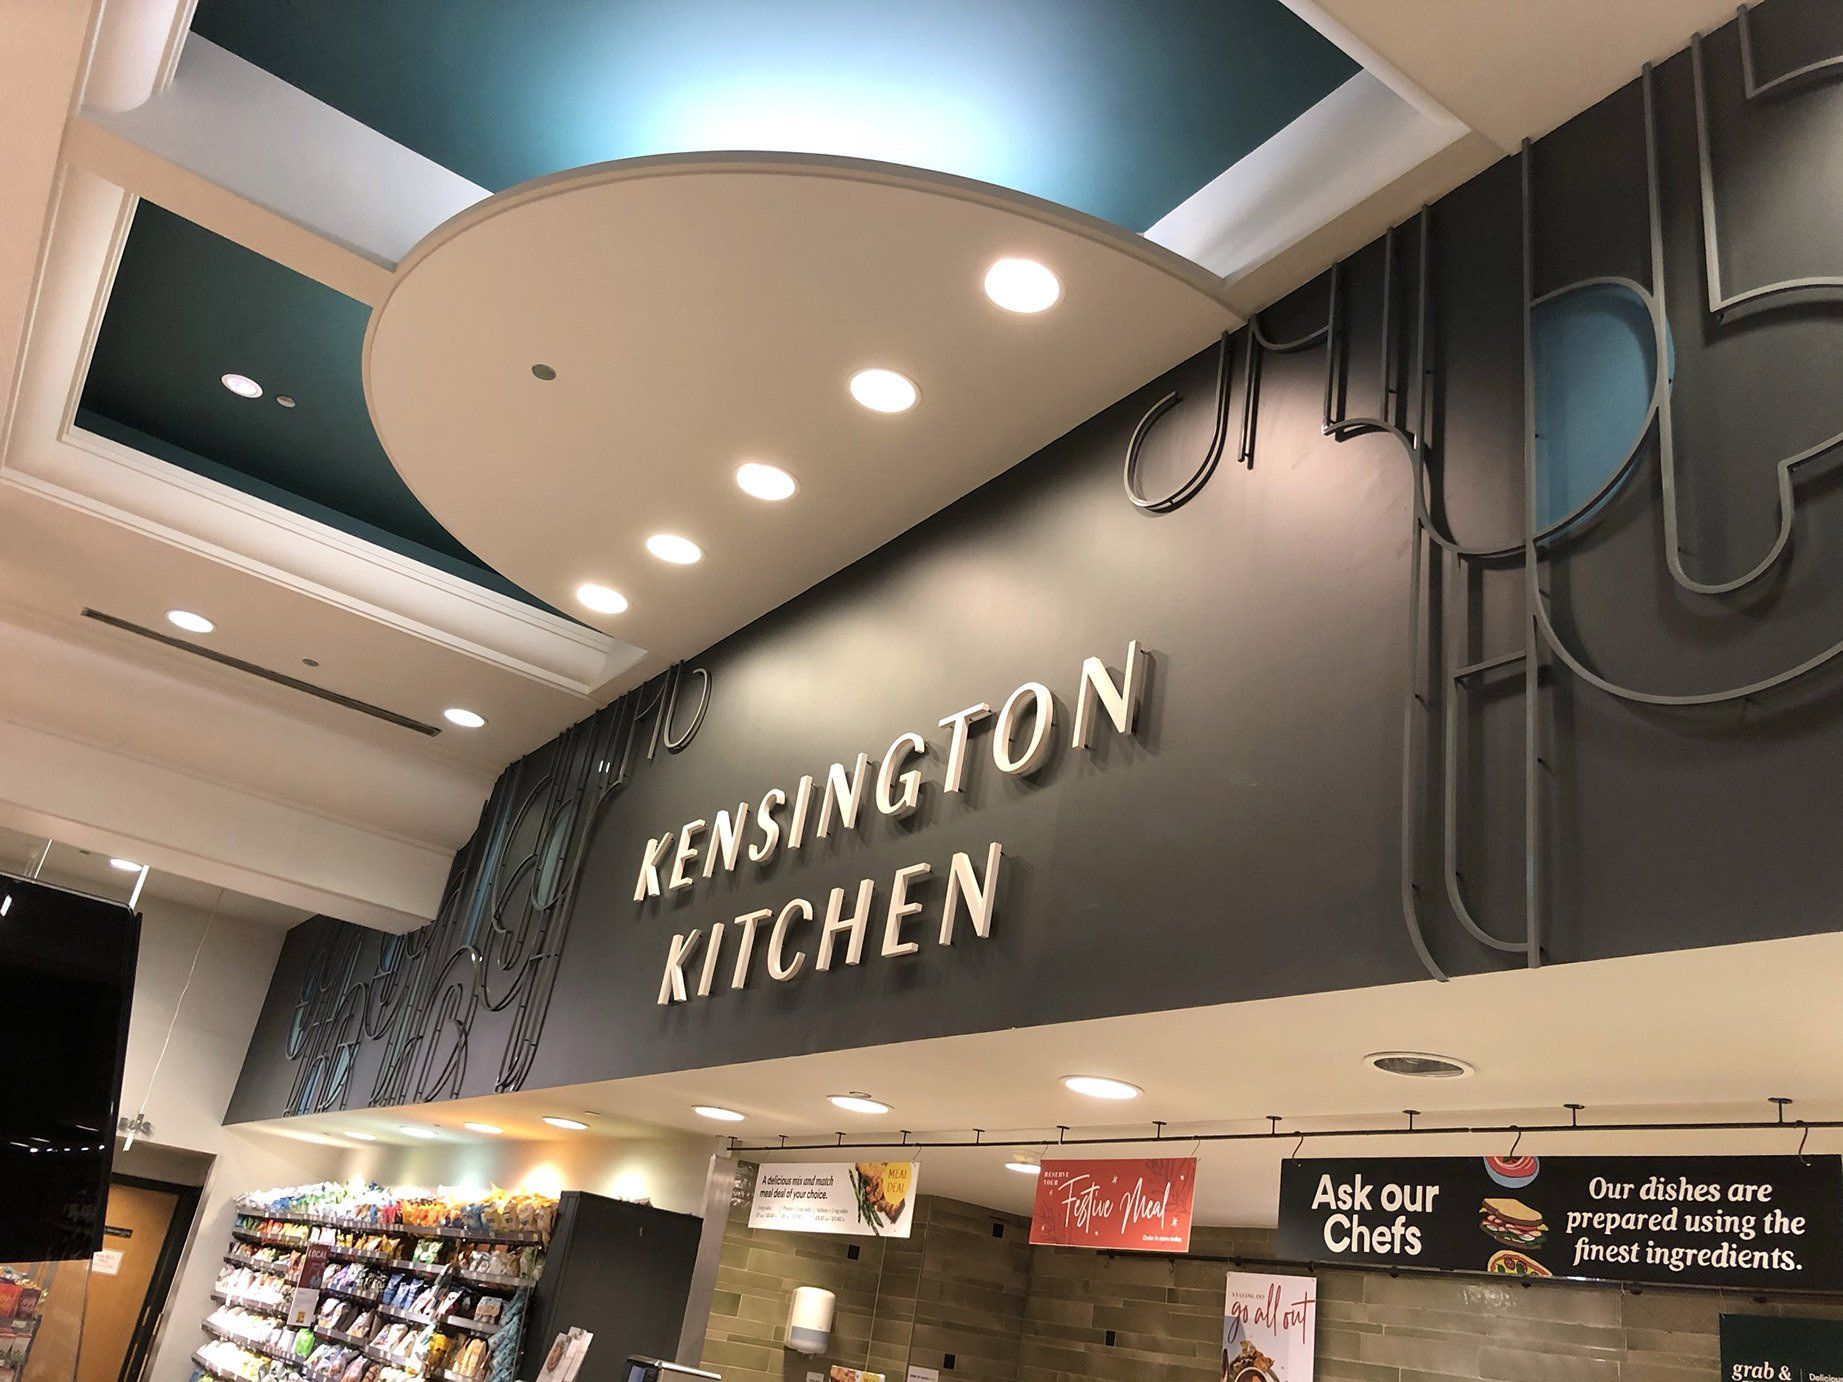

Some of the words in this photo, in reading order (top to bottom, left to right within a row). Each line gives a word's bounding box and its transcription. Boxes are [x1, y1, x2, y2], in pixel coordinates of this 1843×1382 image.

[633, 640, 1142, 901] KENSINGTON
[657, 842, 1002, 1005] KITCHEN
[762, 1176, 767, 1185] A
[767, 1175, 792, 1186] delicious
[792, 1177, 803, 1186] mix
[803, 1176, 815, 1186] and
[815, 1175, 834, 1187] match
[886, 1182, 906, 1193] DEAL
[888, 1168, 907, 1179] MEAL
[1589, 1177, 1634, 1200] Our
[1639, 1176, 1721, 1202] dishes
[1727, 1183, 1773, 1202] are
[759, 1189, 773, 1198] meal
[773, 1189, 785, 1199] deal
[785, 1188, 792, 1199] of
[792, 1190, 806, 1200] your
[806, 1189, 828, 1199] choice.
[1058, 1174, 1114, 1234] Festive
[1119, 1177, 1171, 1235] Meal
[1311, 1174, 1373, 1211] Ask
[1380, 1183, 1440, 1213] our
[1323, 1213, 1422, 1256] Chefs
[1565, 1207, 1678, 1235] prepared
[1684, 1209, 1756, 1241] using
[1764, 1209, 1806, 1235] the
[1572, 1237, 1640, 1266] finest
[1646, 1240, 1803, 1272] ingredients.
[1227, 1301, 1249, 1344] go
[1254, 1283, 1281, 1336] all
[1283, 1291, 1316, 1344] out
[1731, 1361, 1775, 1381] grab
[1778, 1365, 1792, 1381] &
